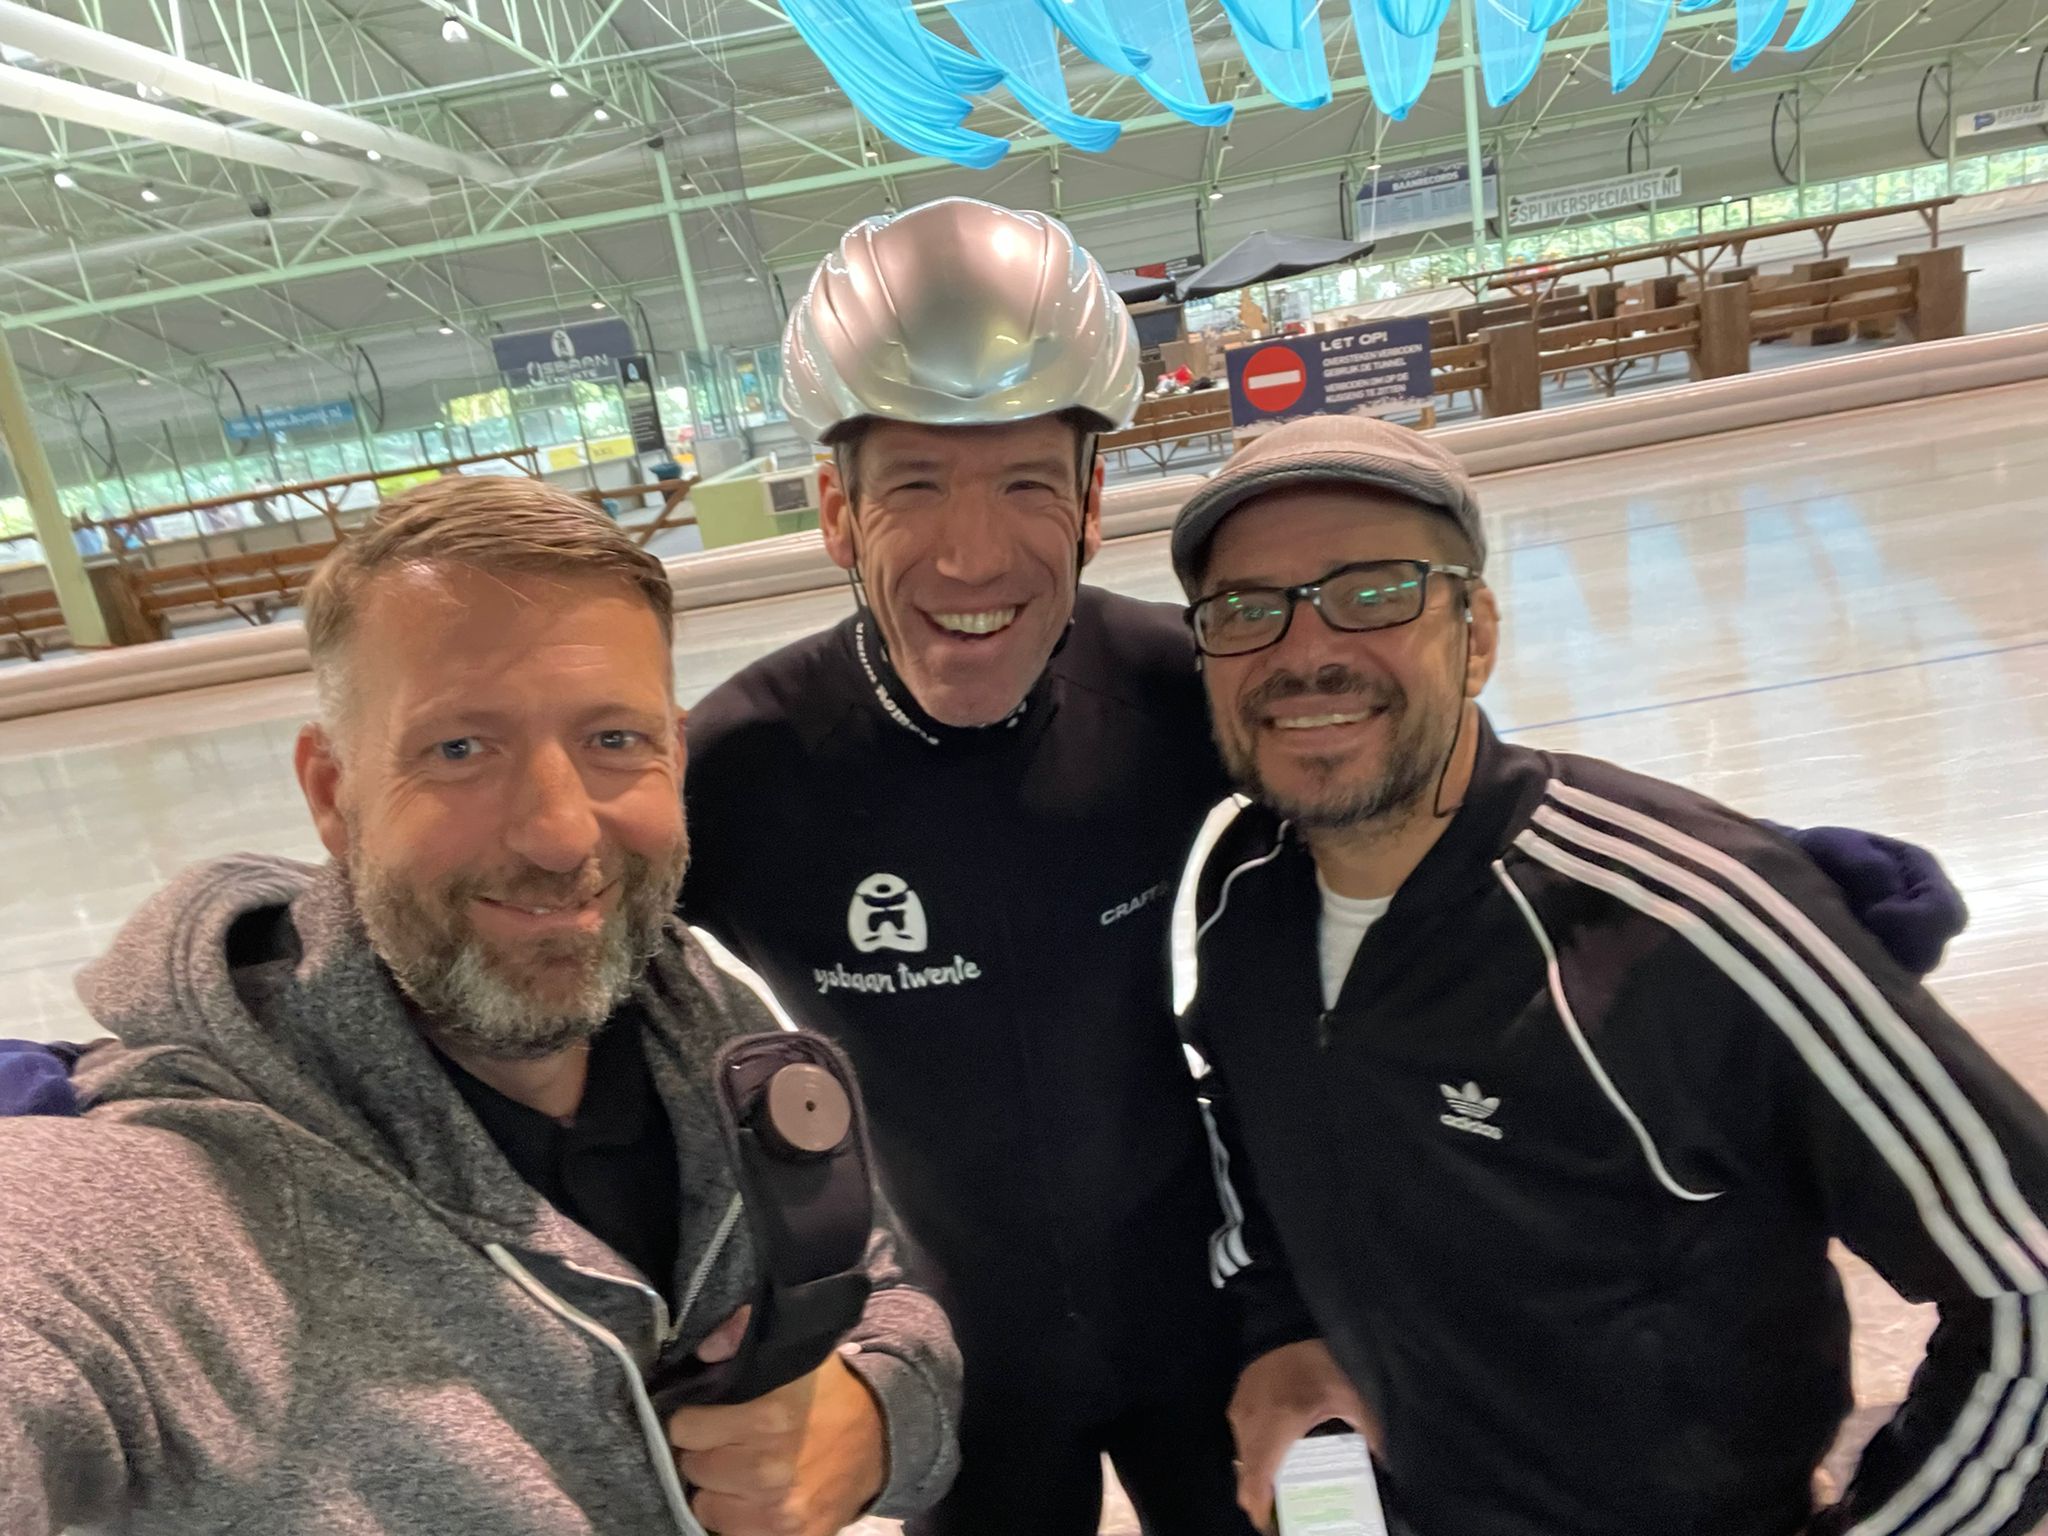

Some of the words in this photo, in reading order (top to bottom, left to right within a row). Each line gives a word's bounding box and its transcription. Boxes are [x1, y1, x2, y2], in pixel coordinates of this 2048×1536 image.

[1518, 177, 1681, 223] SPIJKERSPECIALIST.NL
[1321, 336, 1355, 351] LET
[1358, 331, 1388, 346] OP!
[898, 954, 982, 989] twente
